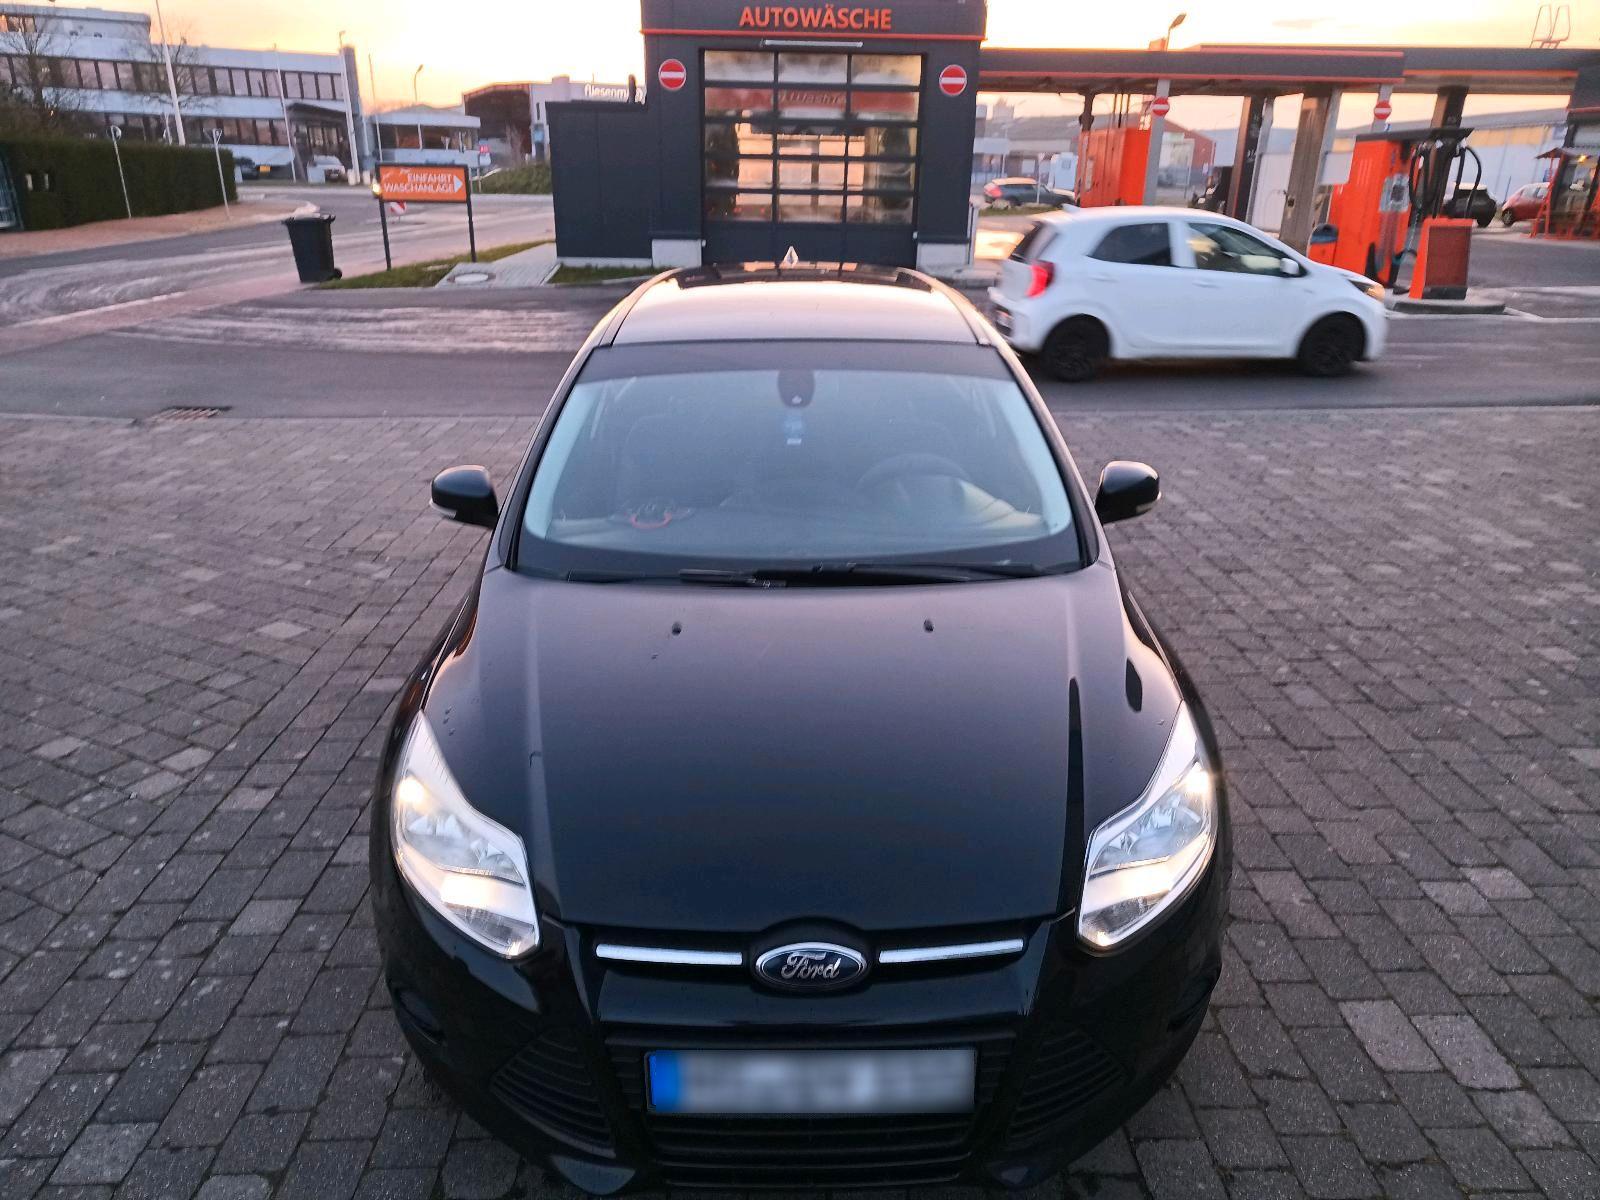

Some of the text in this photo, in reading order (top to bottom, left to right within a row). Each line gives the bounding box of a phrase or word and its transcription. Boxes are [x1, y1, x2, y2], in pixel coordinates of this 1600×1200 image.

[739, 4, 893, 30] AUTOWÄSCHE
[407, 173, 452, 183] EINFAHRT
[384, 182, 454, 193] WASCHANLAGE
[780, 951, 842, 979] Ford
